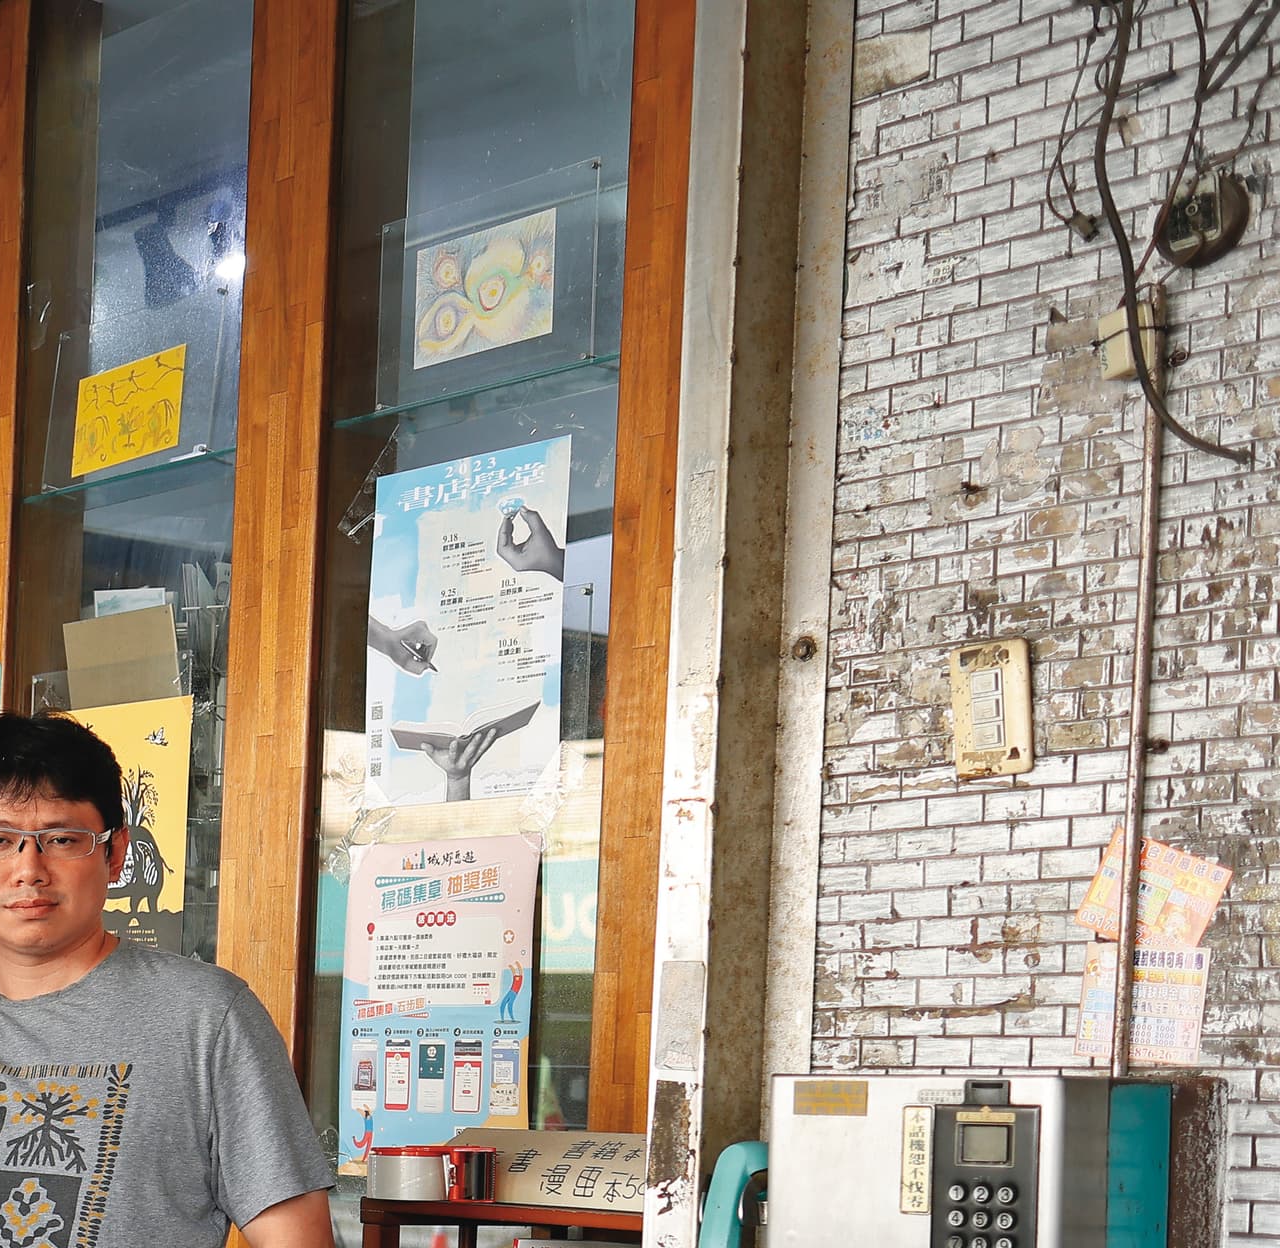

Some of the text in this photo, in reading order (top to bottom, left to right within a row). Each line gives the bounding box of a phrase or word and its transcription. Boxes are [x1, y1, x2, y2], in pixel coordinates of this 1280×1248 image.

[444, 456, 497, 479] 2023
[397, 461, 546, 513] 書店學堂
[442, 533, 459, 543] 9.18
[500, 577, 517, 589] 10.3
[440, 587, 457, 599] 9.25
[498, 637, 519, 648] 10.16
